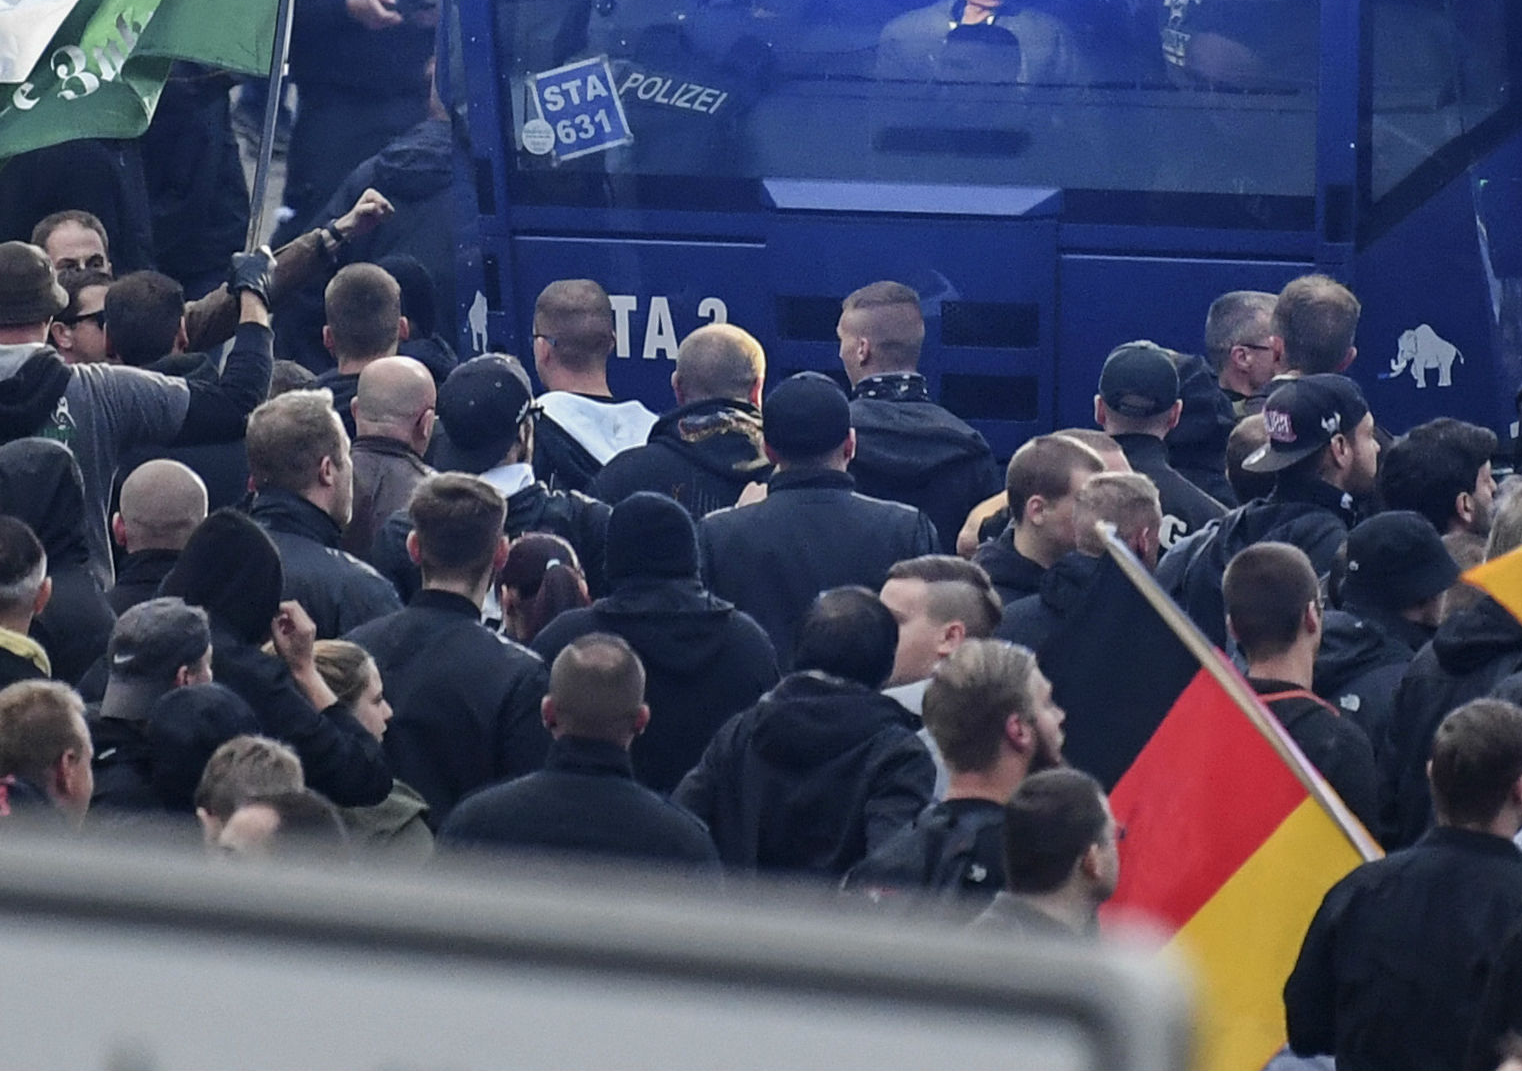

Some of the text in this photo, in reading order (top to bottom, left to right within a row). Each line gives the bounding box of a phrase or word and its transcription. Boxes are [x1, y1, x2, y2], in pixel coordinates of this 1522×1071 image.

[543, 74, 608, 111] STA
[619, 73, 728, 114] POLIZEI
[556, 109, 612, 144] 631
[608, 295, 679, 360] TA
